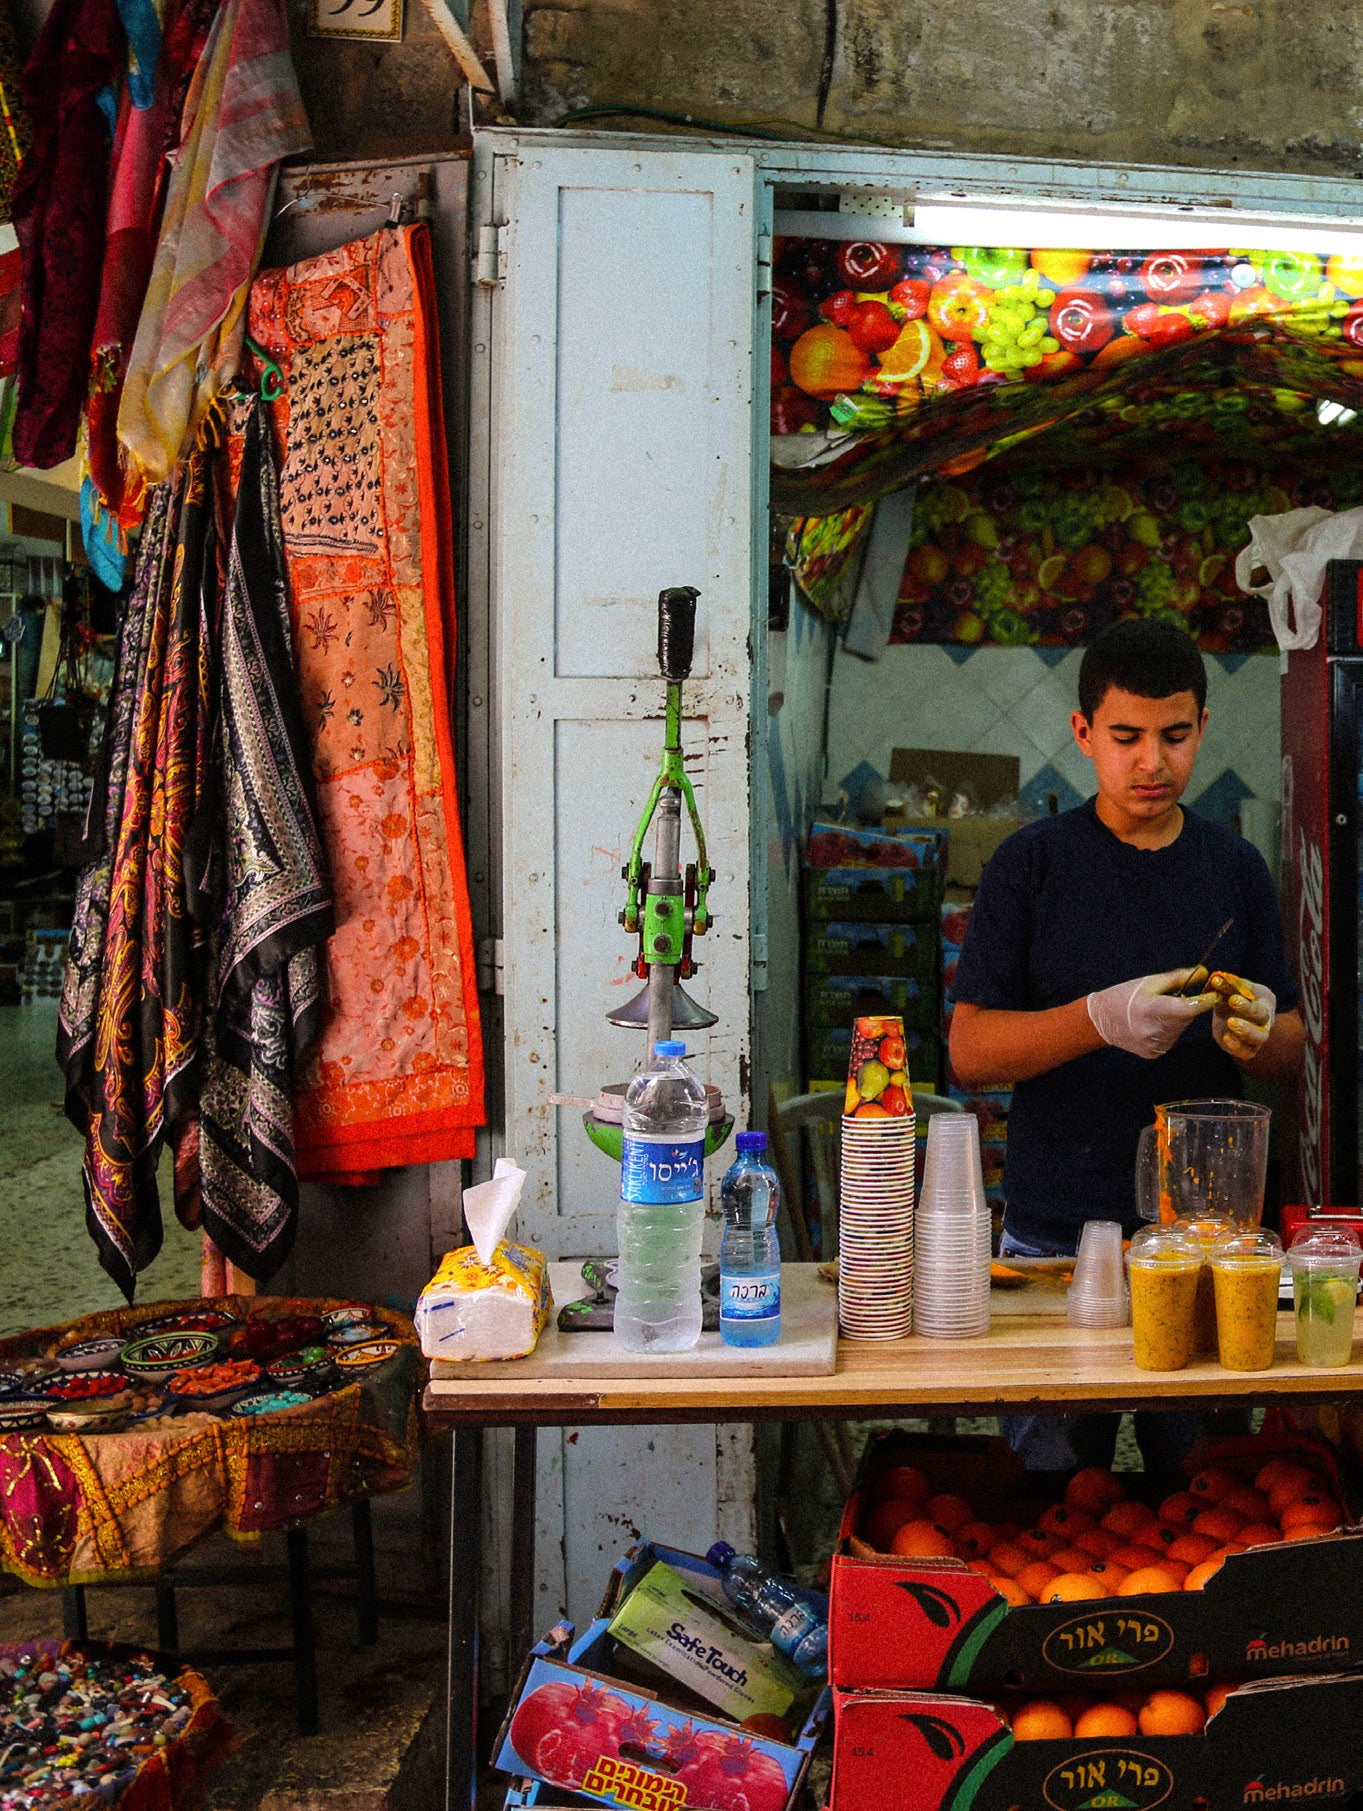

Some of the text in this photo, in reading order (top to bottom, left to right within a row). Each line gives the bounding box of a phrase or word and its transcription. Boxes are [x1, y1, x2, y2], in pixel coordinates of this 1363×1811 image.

[732, 1284, 767, 1299] ברכה
[1060, 1619, 1159, 1650] פרי אור
[1246, 1635, 1350, 1661] mehadrin
[1060, 1759, 1159, 1790] פרי אור
[1091, 1796, 1118, 1808] OR
[1243, 1777, 1345, 1804] mehadrin
